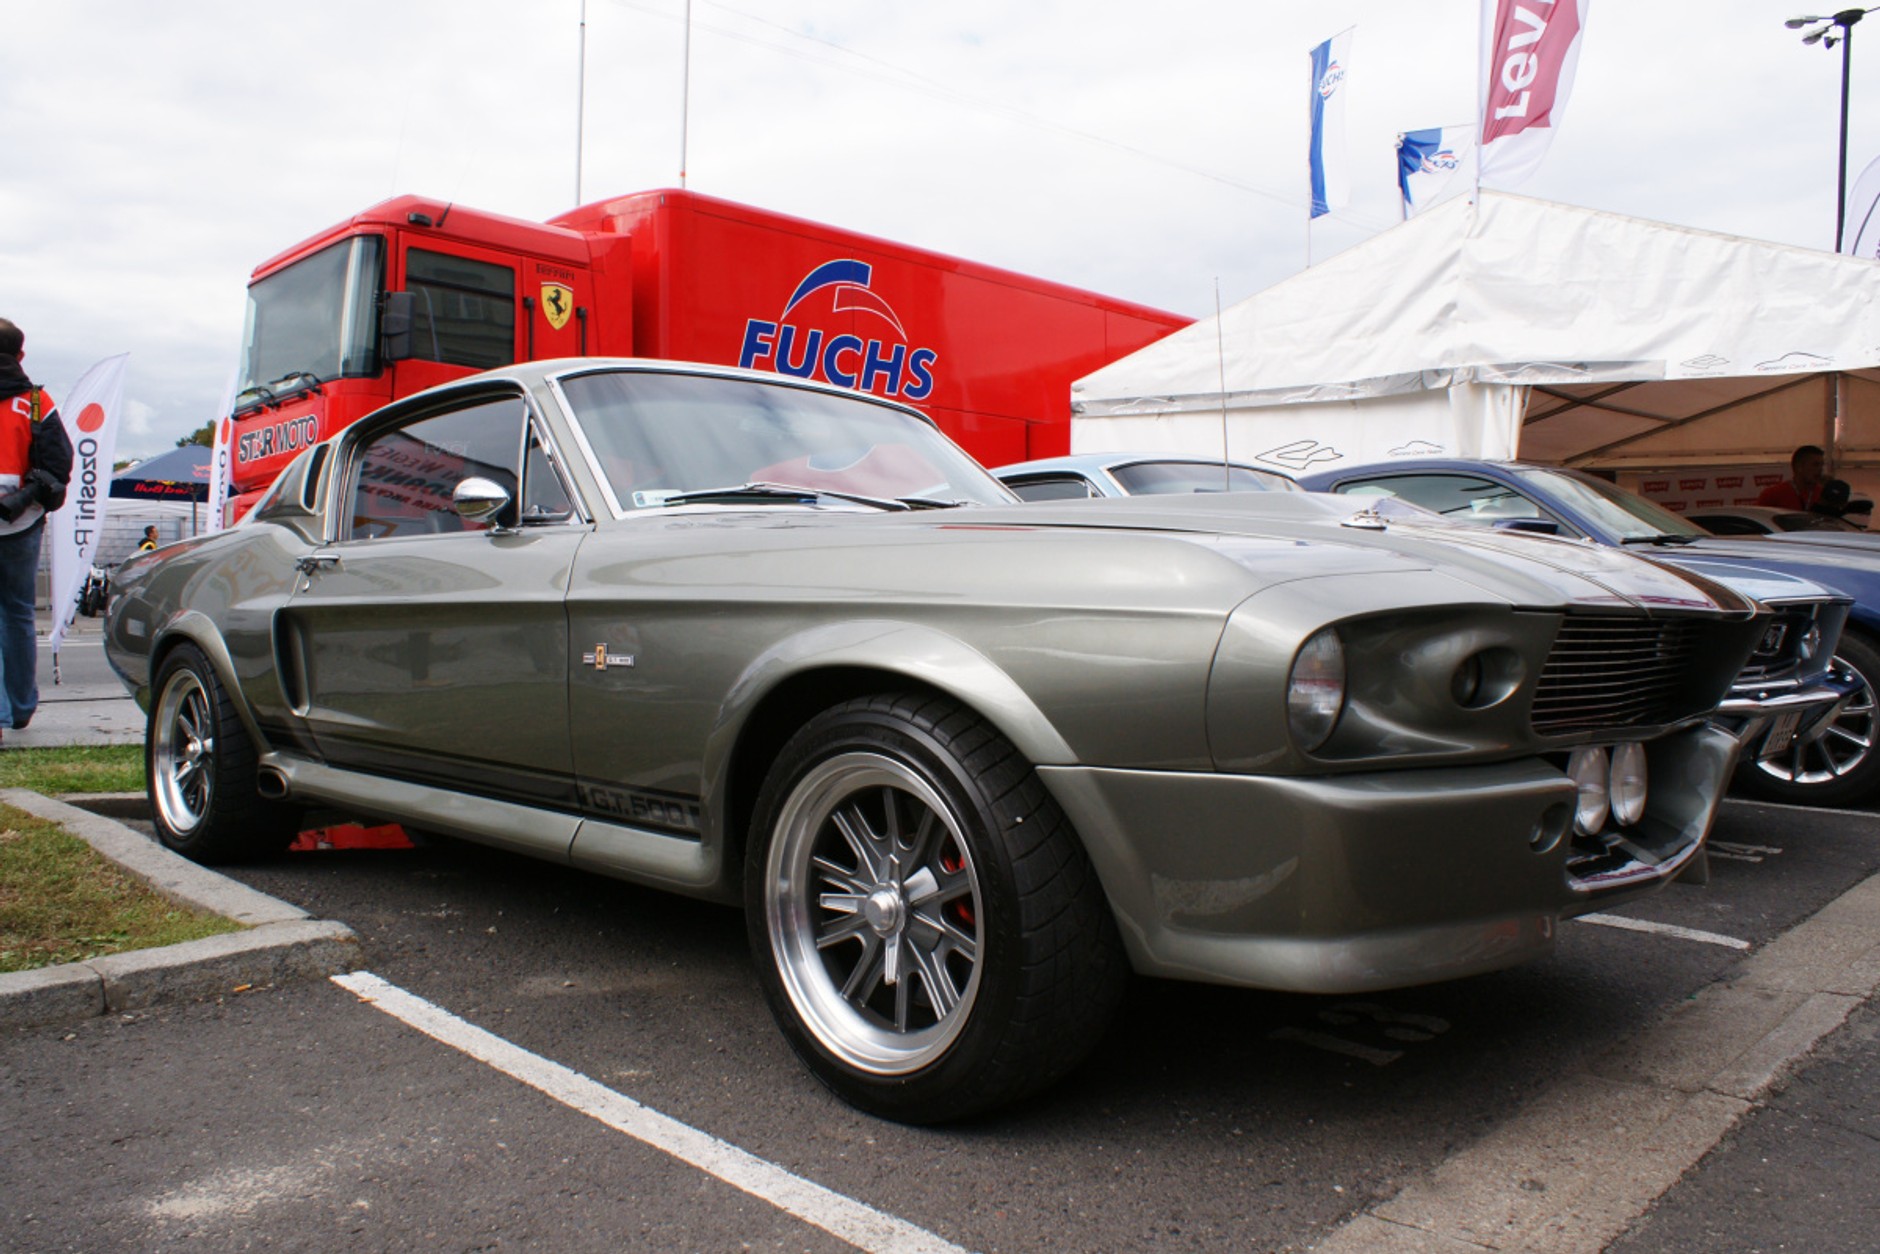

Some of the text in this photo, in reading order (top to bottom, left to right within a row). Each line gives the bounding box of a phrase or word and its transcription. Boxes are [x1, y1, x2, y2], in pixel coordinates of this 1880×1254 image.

[1494, 0, 1557, 120] Lev
[738, 318, 938, 400] FUCHS
[275, 414, 319, 455] MOTO
